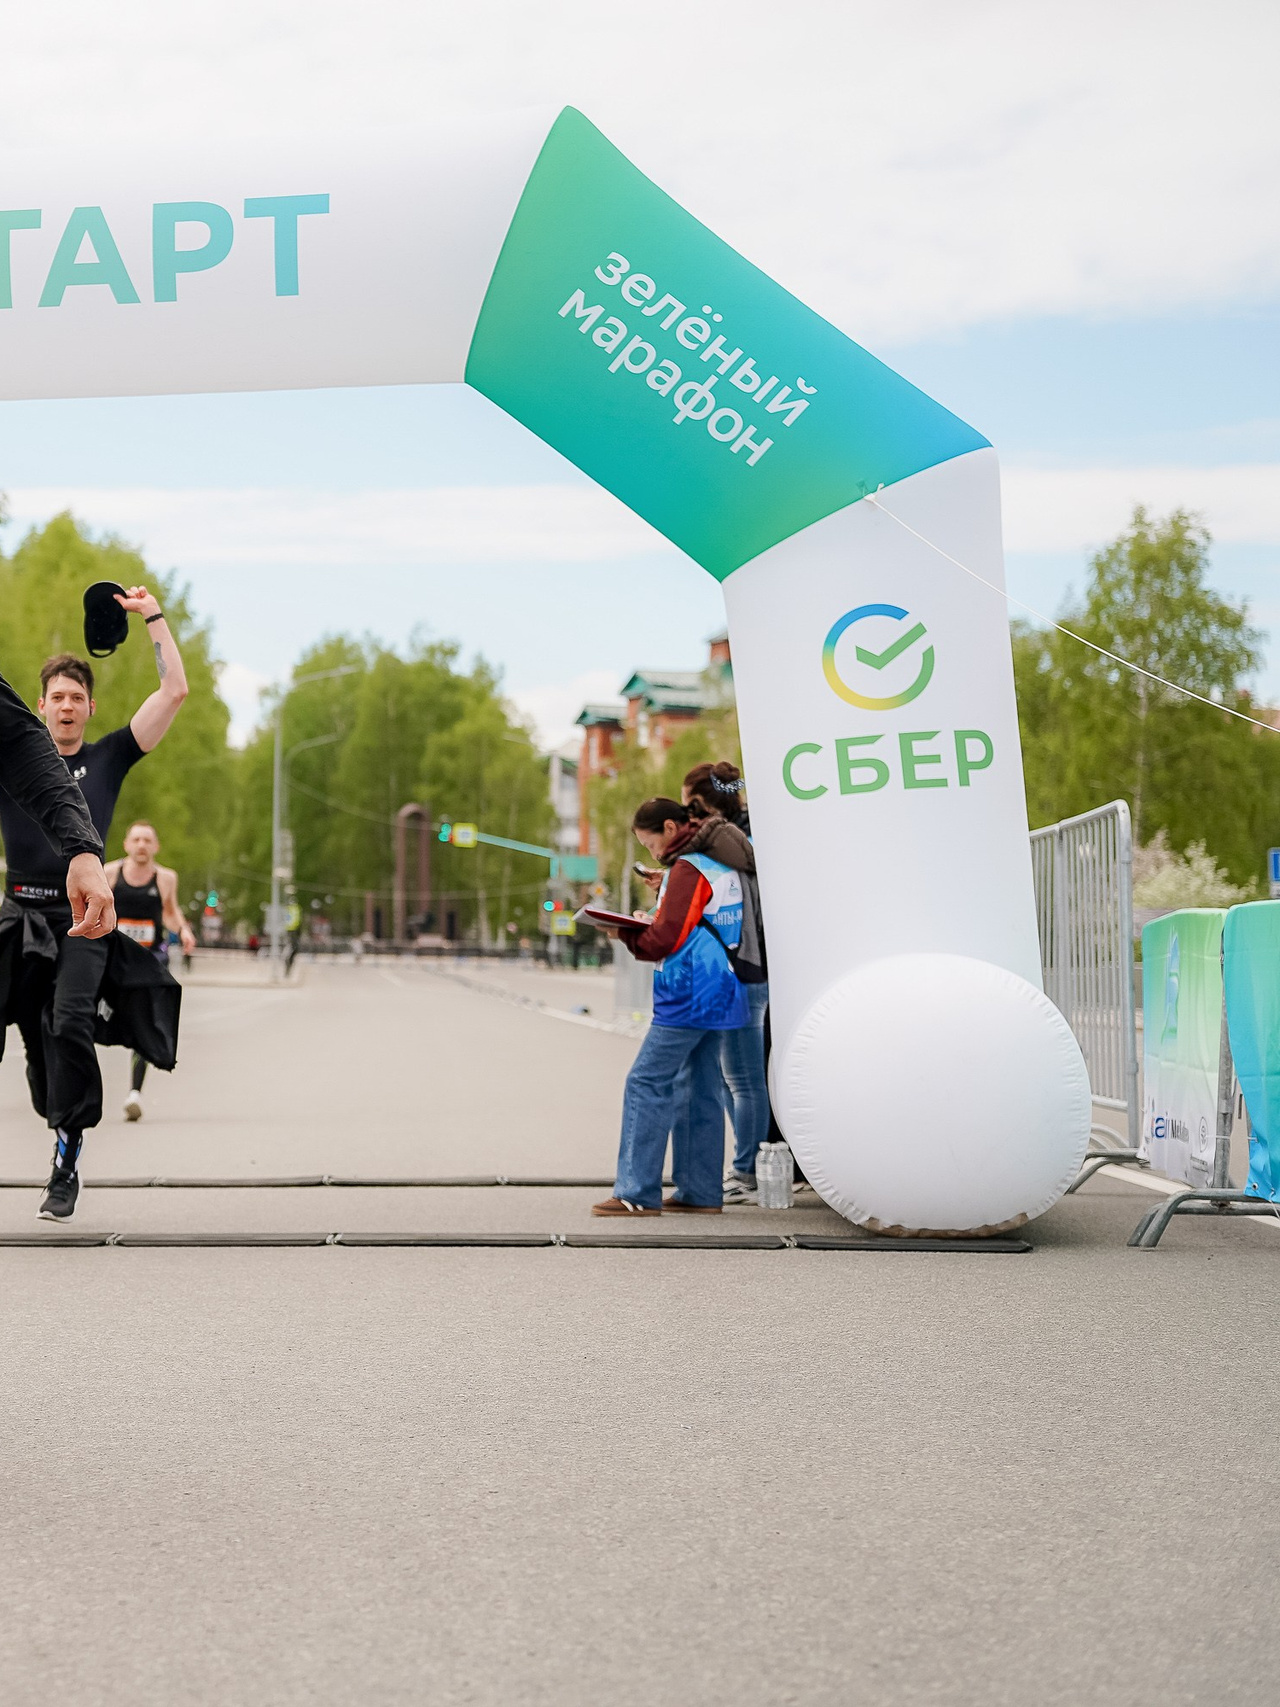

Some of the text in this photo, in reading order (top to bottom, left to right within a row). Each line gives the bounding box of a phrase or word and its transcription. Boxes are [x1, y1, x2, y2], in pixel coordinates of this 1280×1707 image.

[557, 288, 774, 467] марафон
[594, 251, 818, 428] зелёный
[782, 730, 994, 801] СБЕР
